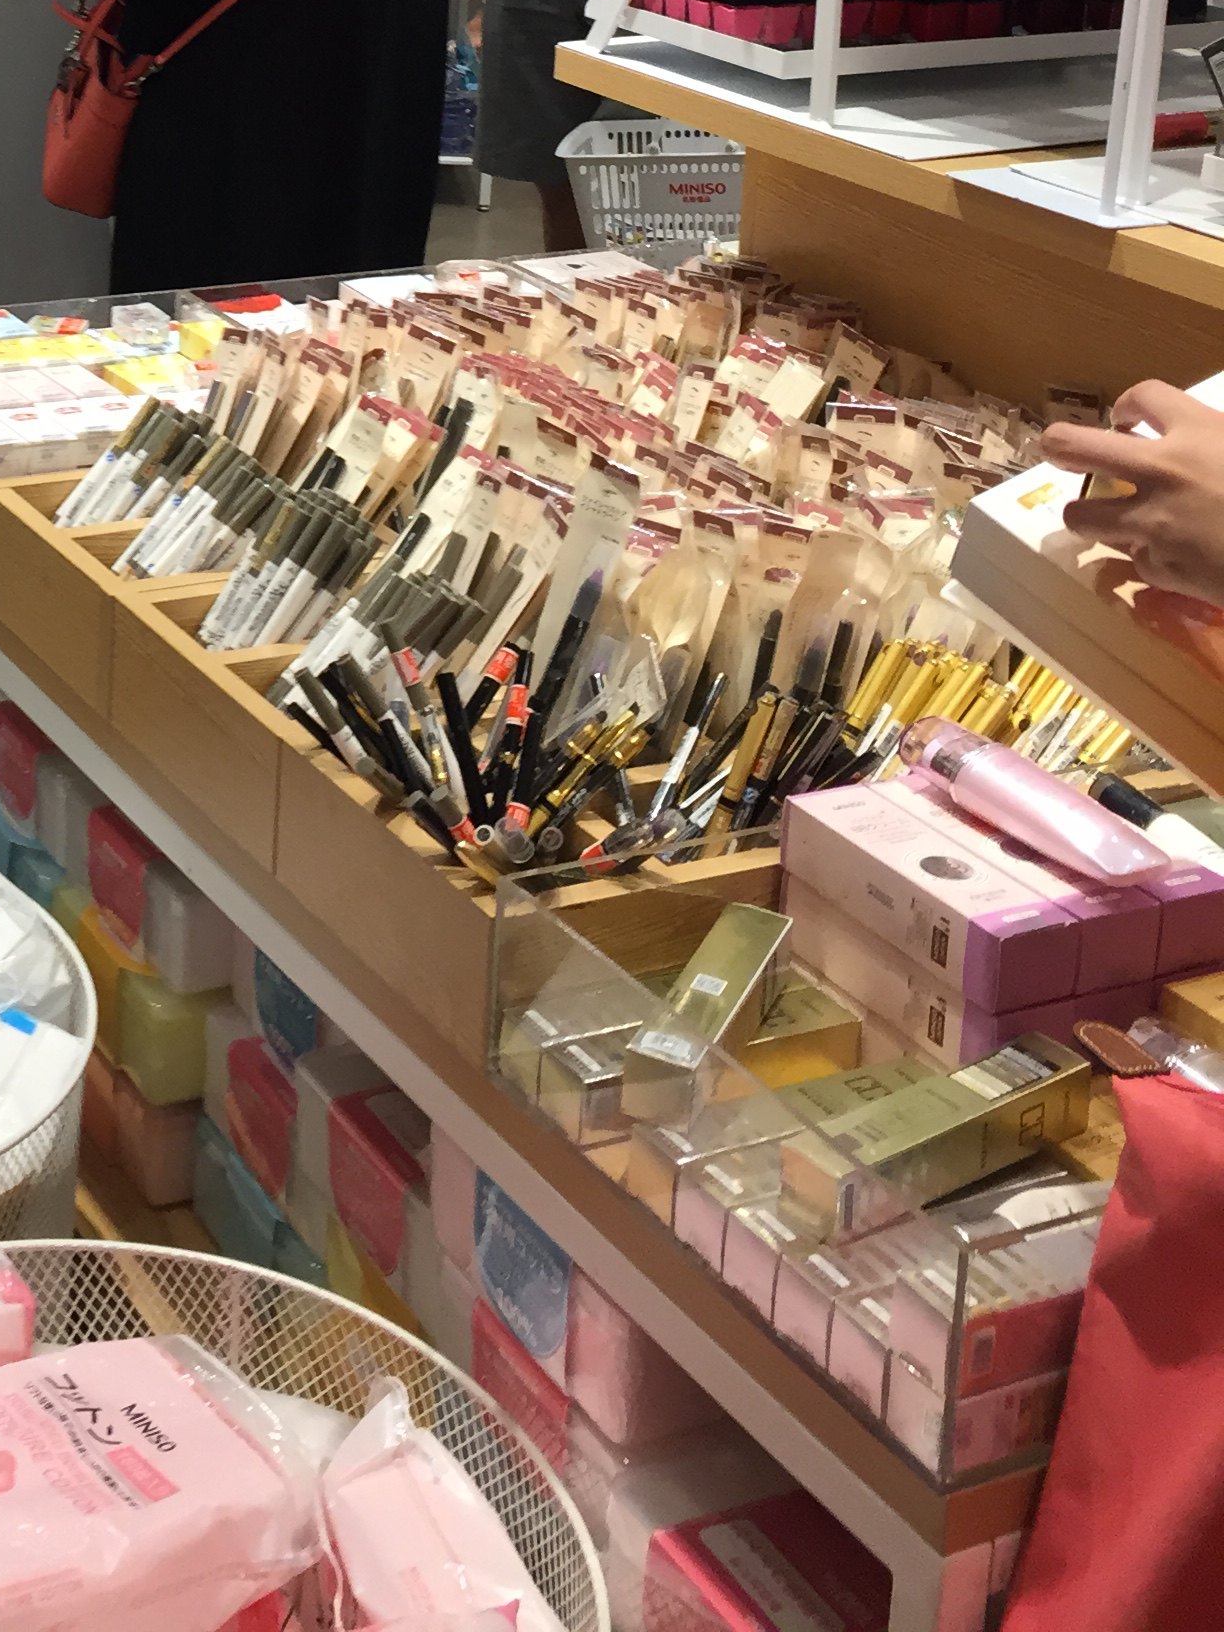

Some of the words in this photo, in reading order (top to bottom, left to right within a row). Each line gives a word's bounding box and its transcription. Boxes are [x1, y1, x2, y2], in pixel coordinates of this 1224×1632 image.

[669, 182, 727, 195] MINISO
[43, 1373, 123, 1445] コットン
[120, 1402, 178, 1453] MINISO
